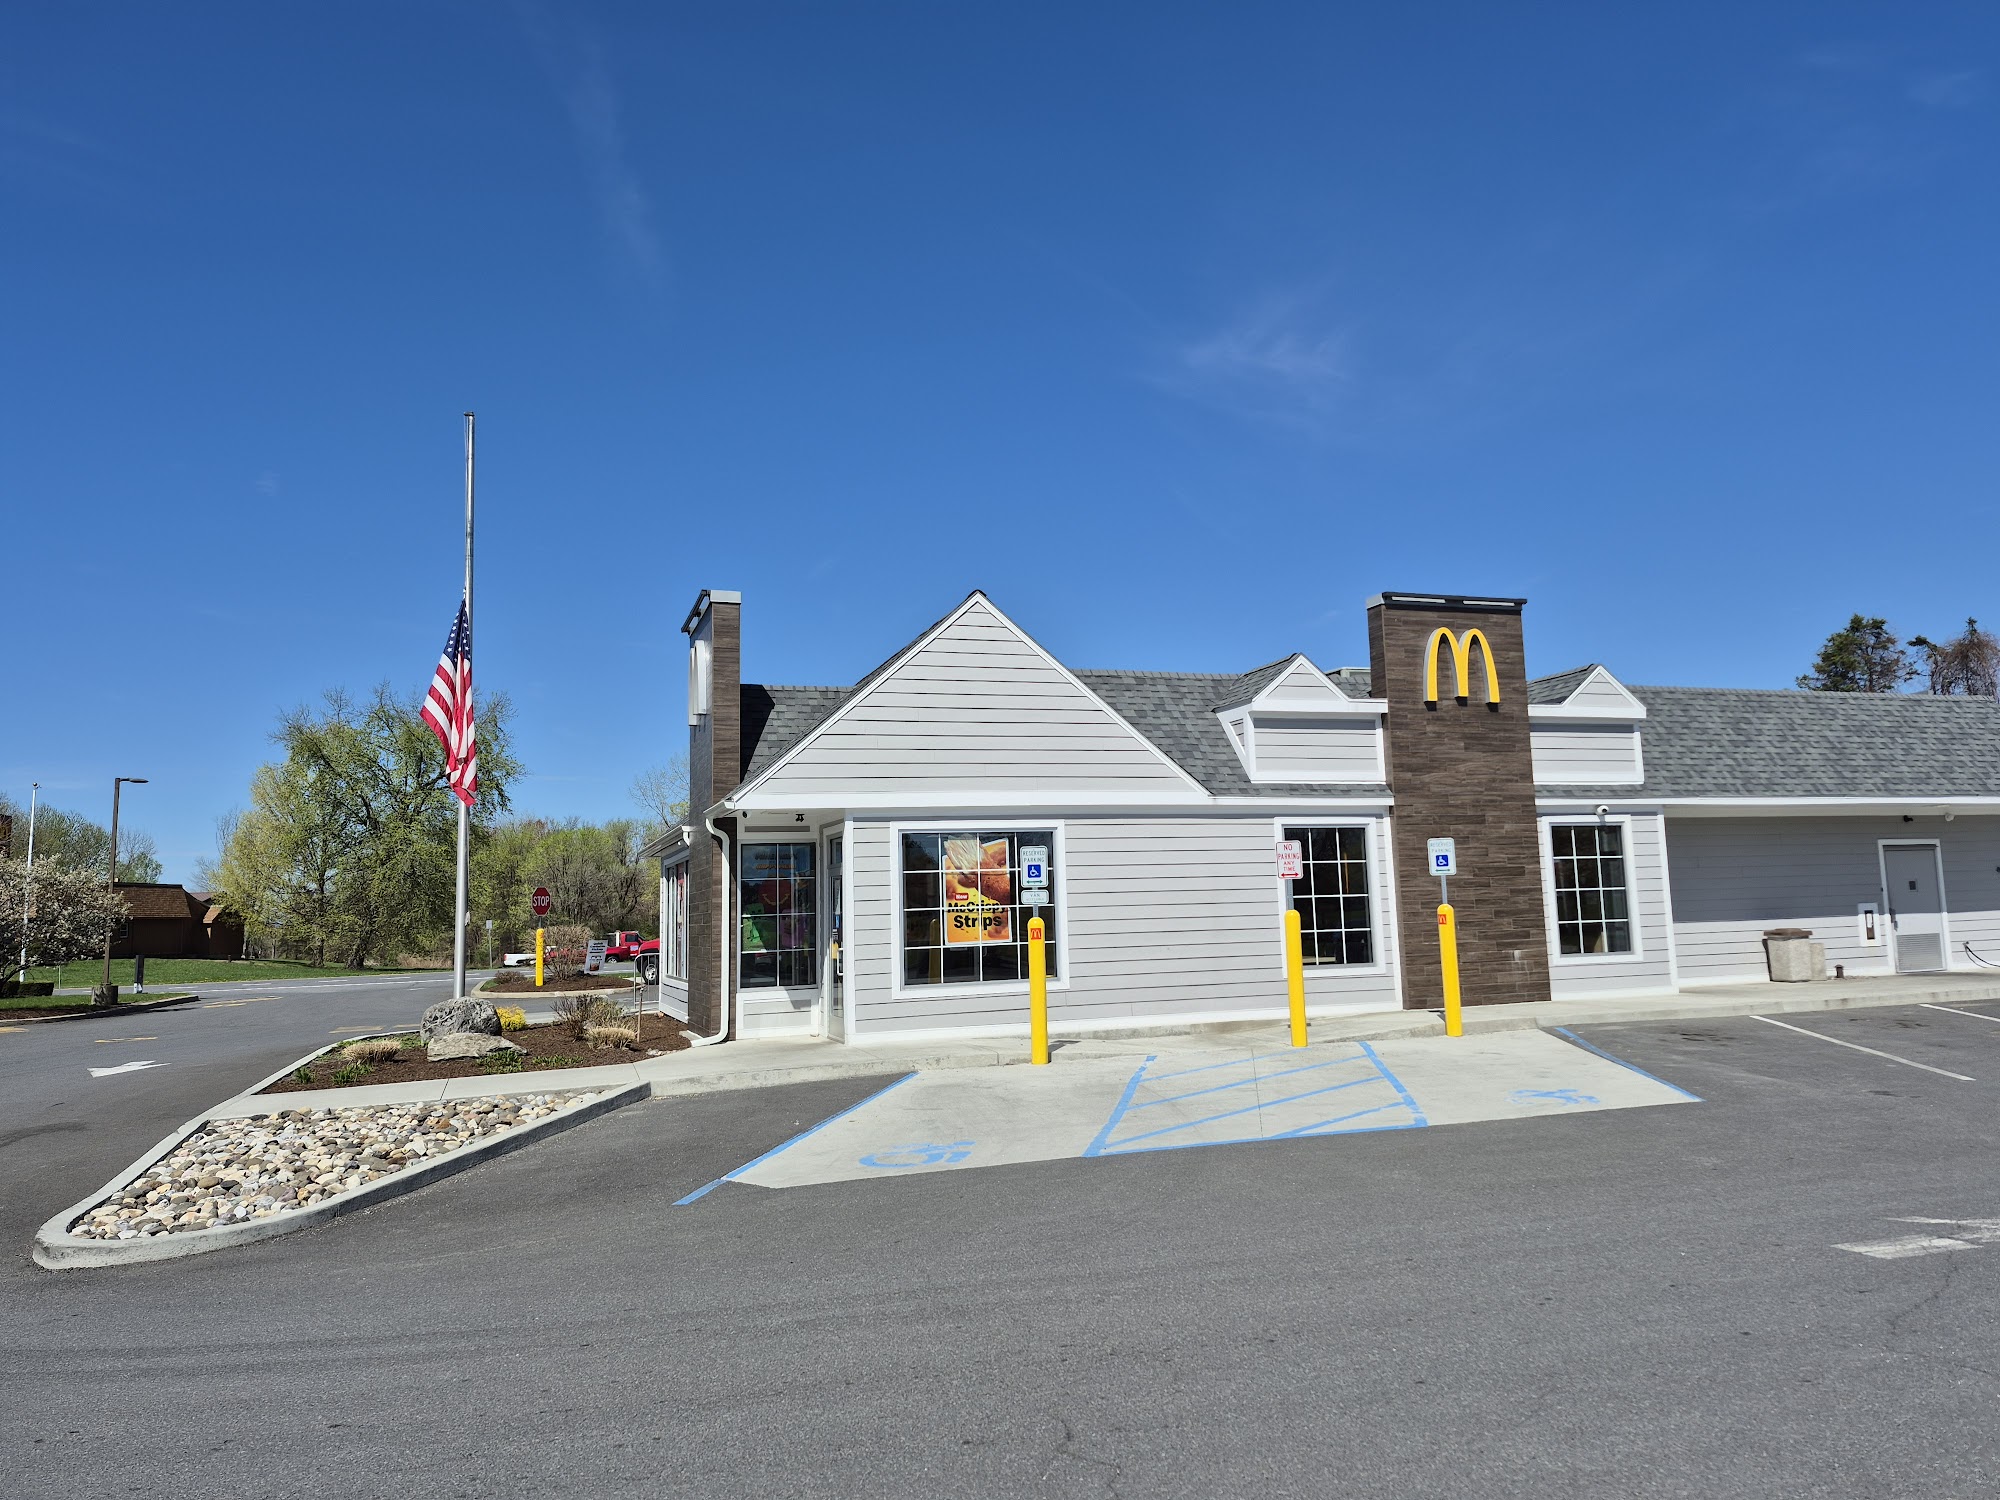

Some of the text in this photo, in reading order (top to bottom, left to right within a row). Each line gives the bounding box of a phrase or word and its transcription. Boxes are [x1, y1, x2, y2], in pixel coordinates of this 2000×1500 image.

[1423, 627, 1500, 702] M
[532, 896, 550, 907] STOP
[947, 900, 1006, 914] McCrispy
[953, 915, 1002, 931] Strps
